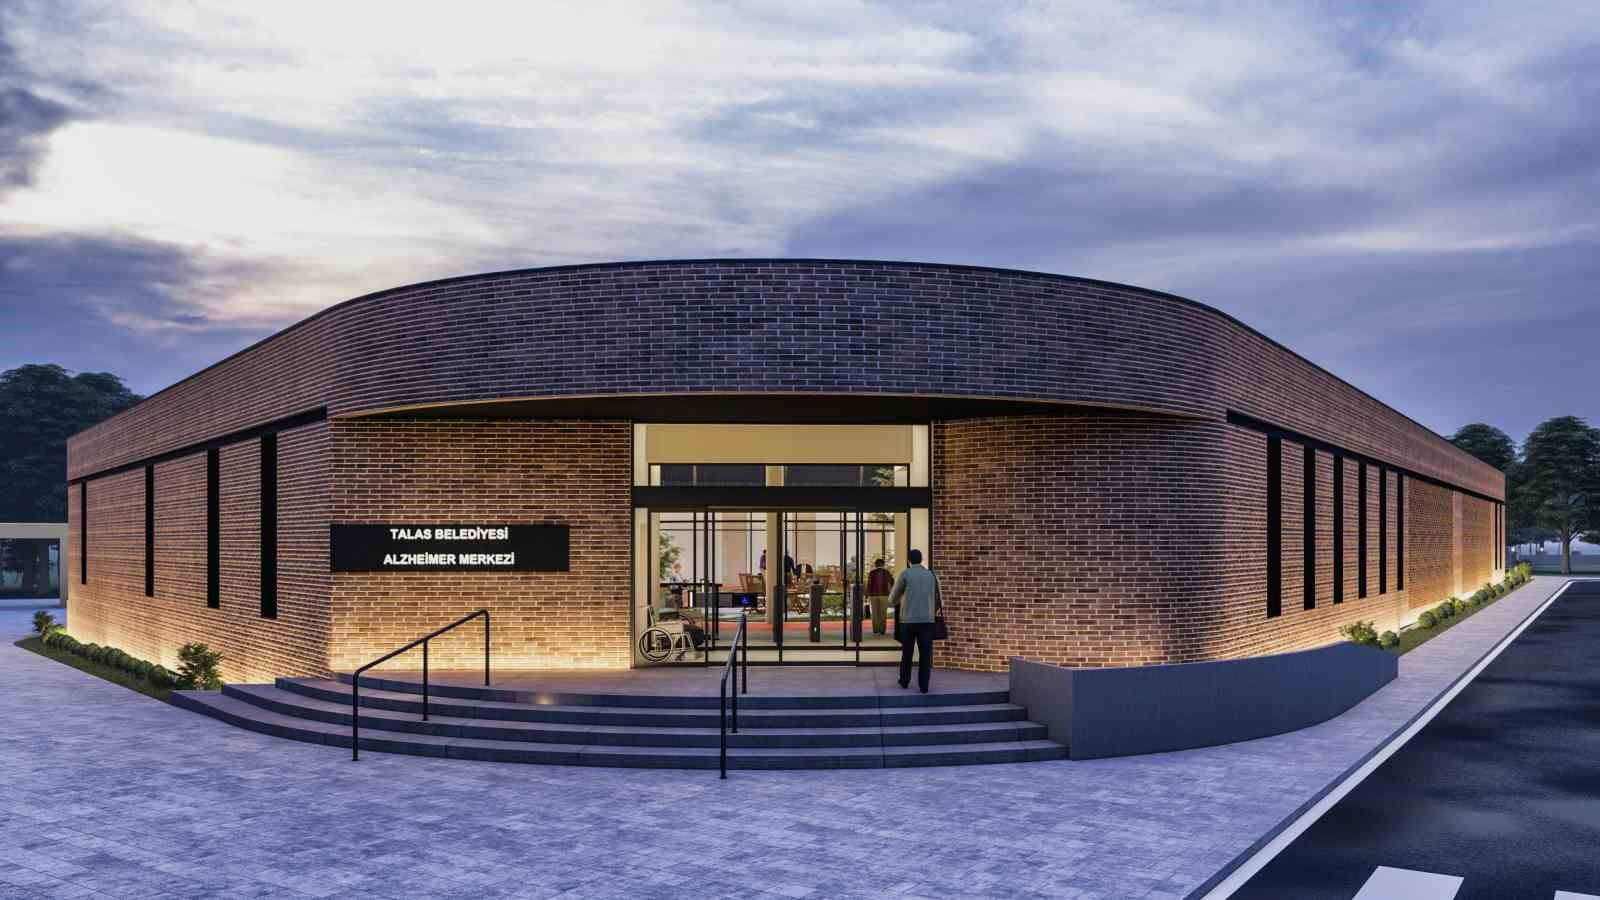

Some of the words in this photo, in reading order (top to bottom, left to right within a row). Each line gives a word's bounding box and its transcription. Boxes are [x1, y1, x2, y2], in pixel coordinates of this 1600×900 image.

[389, 528, 432, 540] TALAS
[434, 526, 508, 540] BELEDİYESİ
[458, 551, 515, 565] MERKEZİ
